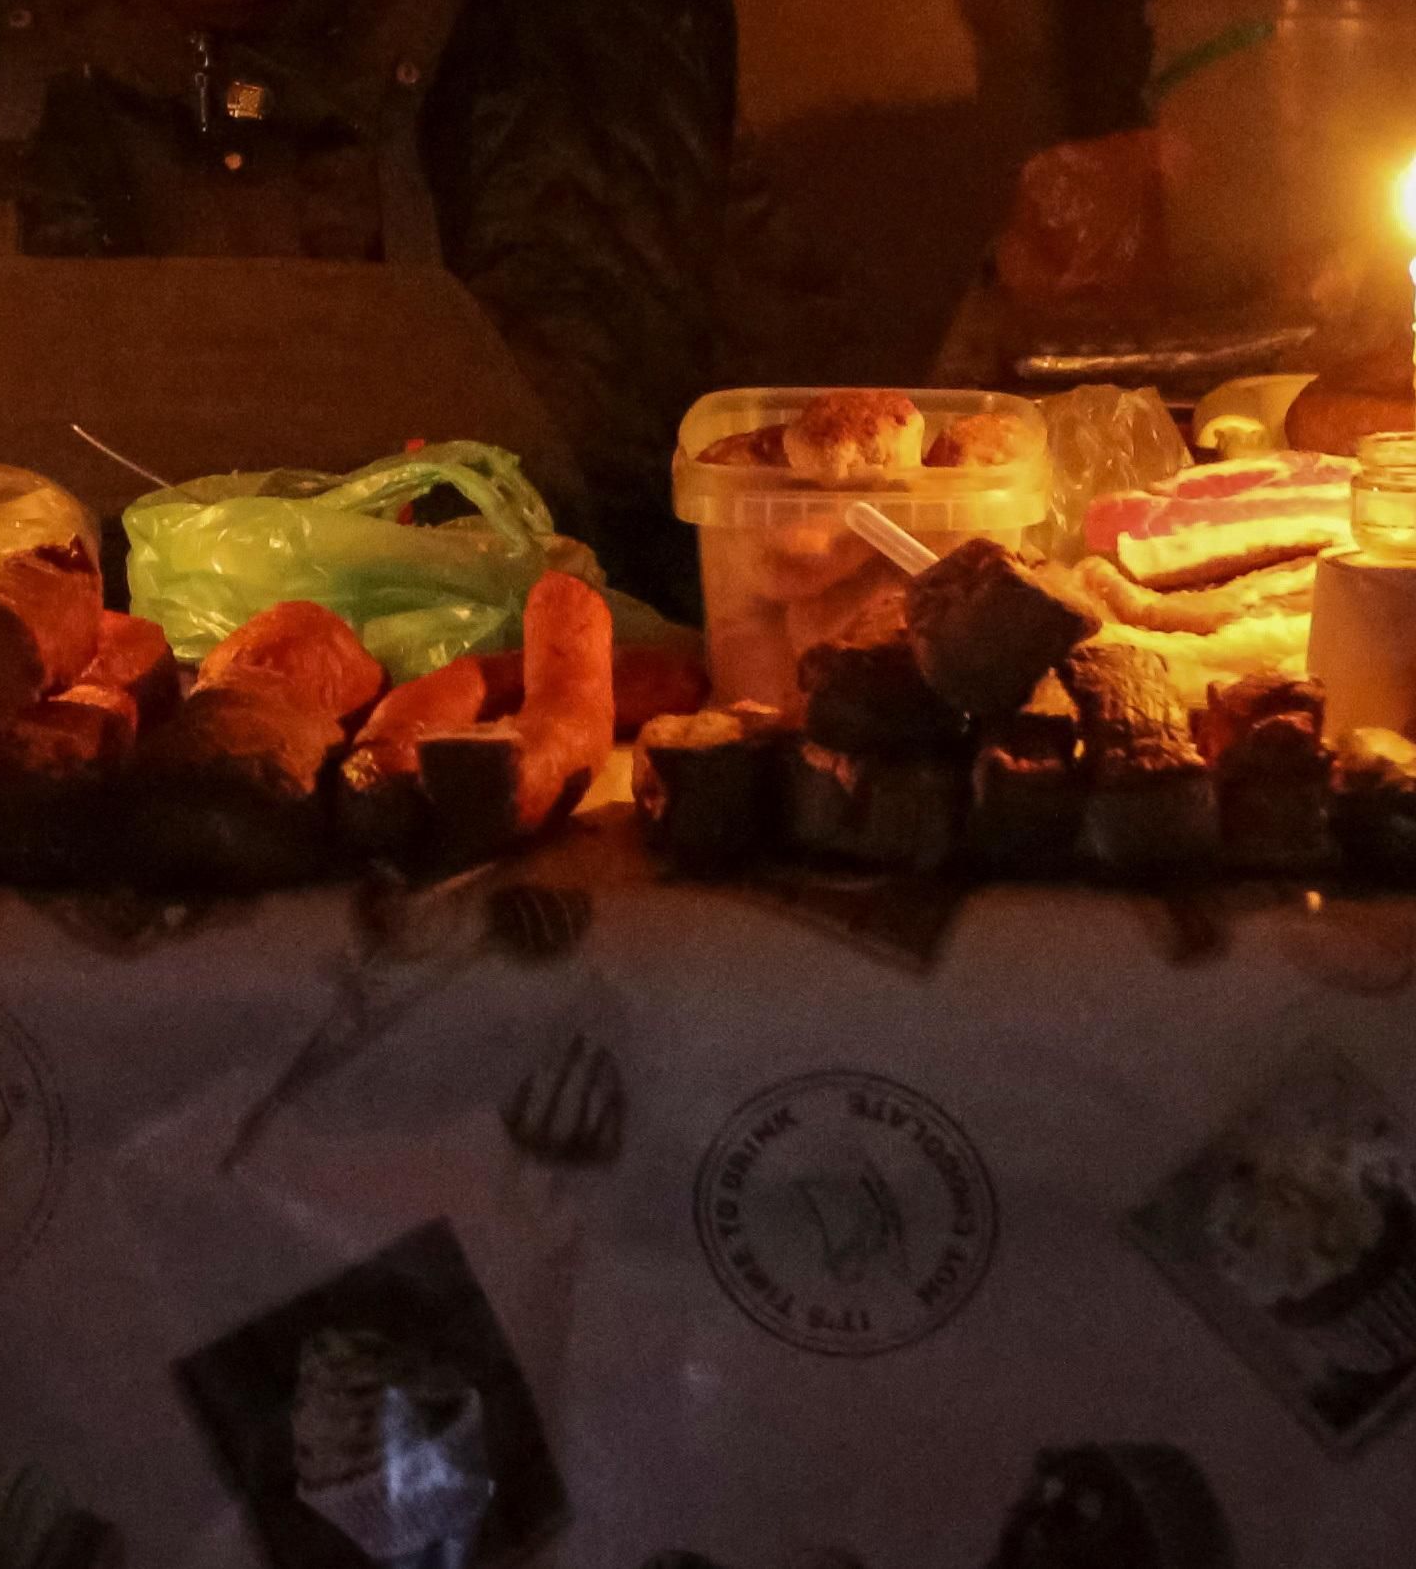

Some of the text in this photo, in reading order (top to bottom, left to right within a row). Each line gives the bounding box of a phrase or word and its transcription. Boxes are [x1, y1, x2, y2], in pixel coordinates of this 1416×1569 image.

[718, 1107, 870, 1330] IT'S TIME TO DRINK
[849, 1094, 975, 1305] HOT CHOCOLATE
